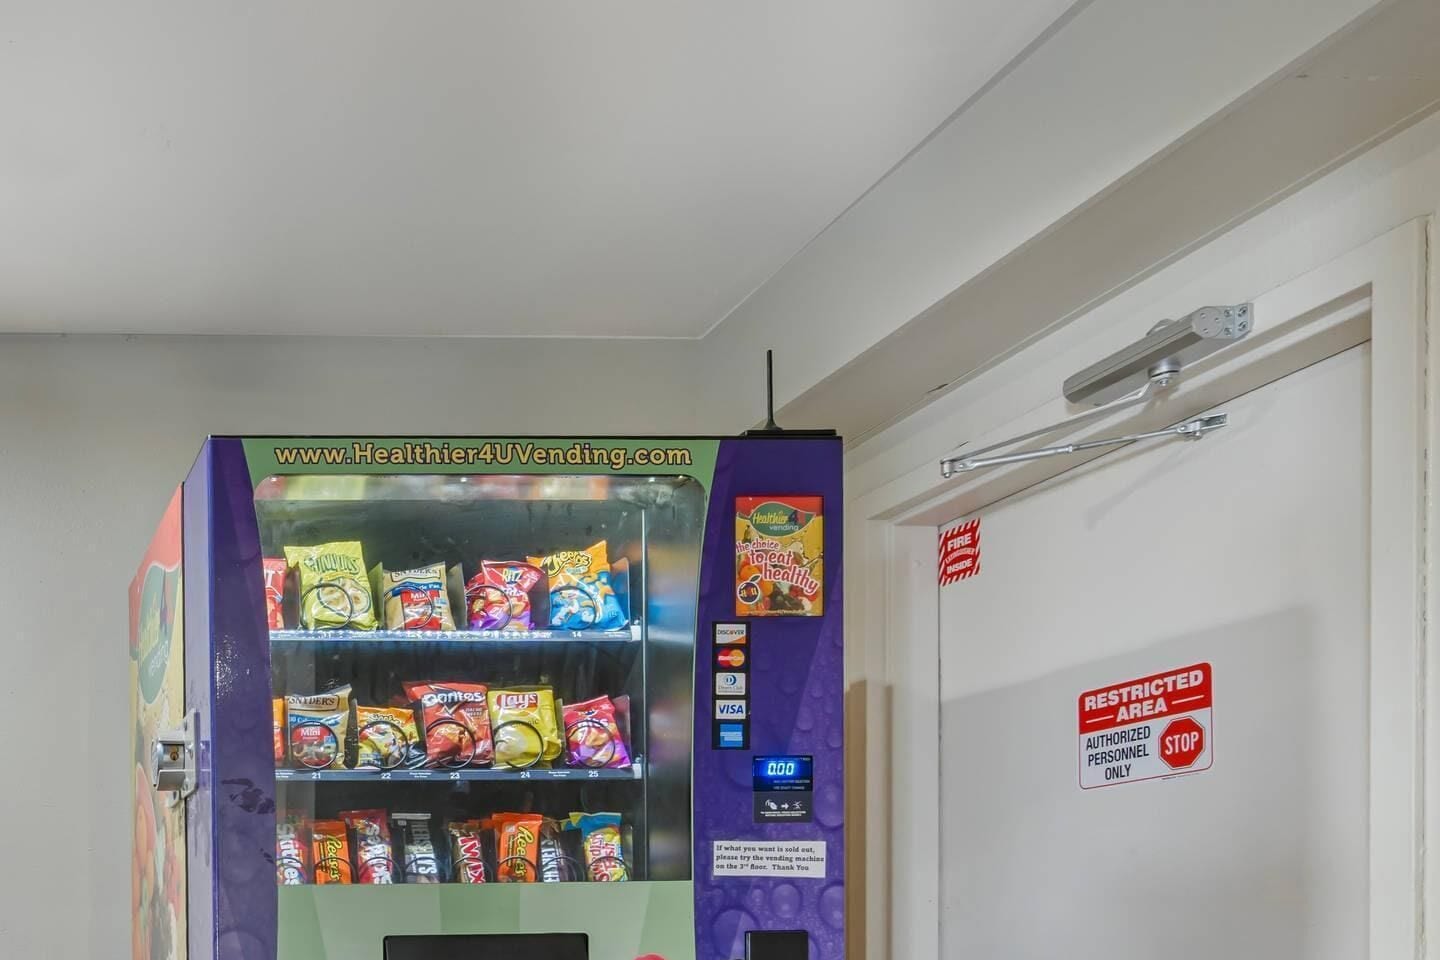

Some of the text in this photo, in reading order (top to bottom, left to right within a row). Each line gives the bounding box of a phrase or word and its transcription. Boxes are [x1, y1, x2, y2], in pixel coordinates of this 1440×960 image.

[274, 442, 692, 469] www.Healthier4UVending.com
[752, 538, 779, 550] choice
[948, 532, 972, 551] FIRE
[750, 549, 793, 565] to eat
[763, 564, 819, 594] healthy
[1085, 669, 1204, 711] RESTRICTED
[719, 704, 744, 714] VISA
[1116, 697, 1168, 722] AREA
[1086, 725, 1151, 751] AUTHORIZED
[1165, 731, 1200, 755] STOP
[1088, 743, 1150, 767] PERSONNEL
[520, 771, 531, 779] 24
[588, 770, 599, 778] 25
[1105, 763, 1132, 781] ONLY
[326, 834, 343, 881] Reese's
[766, 855, 793, 863] vending
